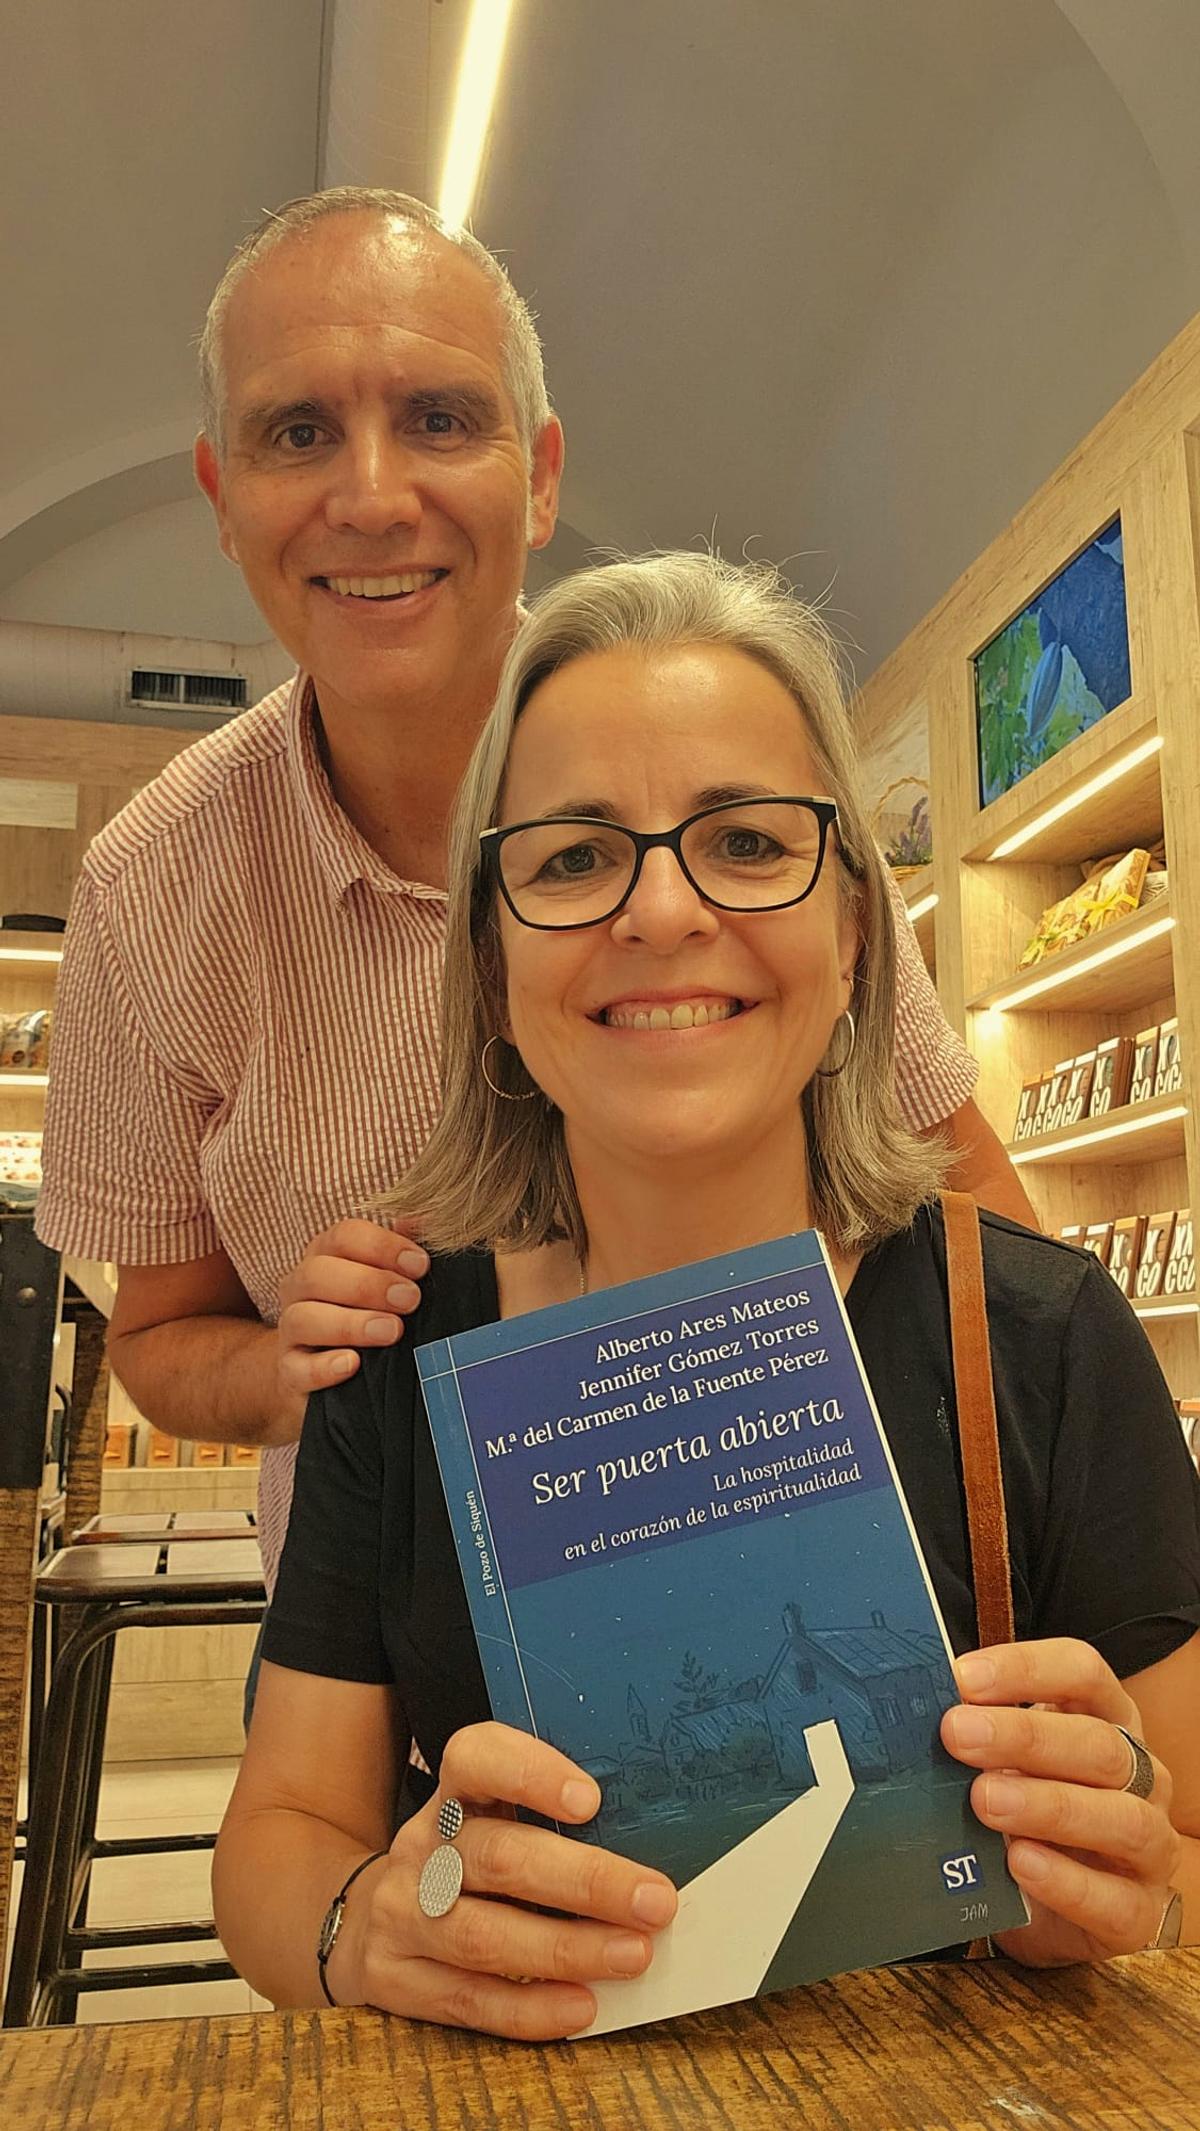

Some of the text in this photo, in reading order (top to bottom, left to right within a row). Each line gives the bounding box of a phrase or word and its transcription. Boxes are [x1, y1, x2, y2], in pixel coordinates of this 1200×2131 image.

[578, 1319, 820, 1400] Jennifer Gómez Torres
[596, 1290, 811, 1364] Alberto Ares Mateos
[485, 1348, 829, 1459] M.ª del Carmen de la Fuente Pérez
[532, 1399, 845, 1505] Ser puerta abierta
[713, 1437, 855, 1492] La hospitalidad
[465, 1490, 497, 1597] El Pozo de Siquén
[564, 1462, 863, 1560] en el corazón de la espiritualidad
[942, 1854, 977, 1889] ST
[960, 1903, 989, 1922] JAM
